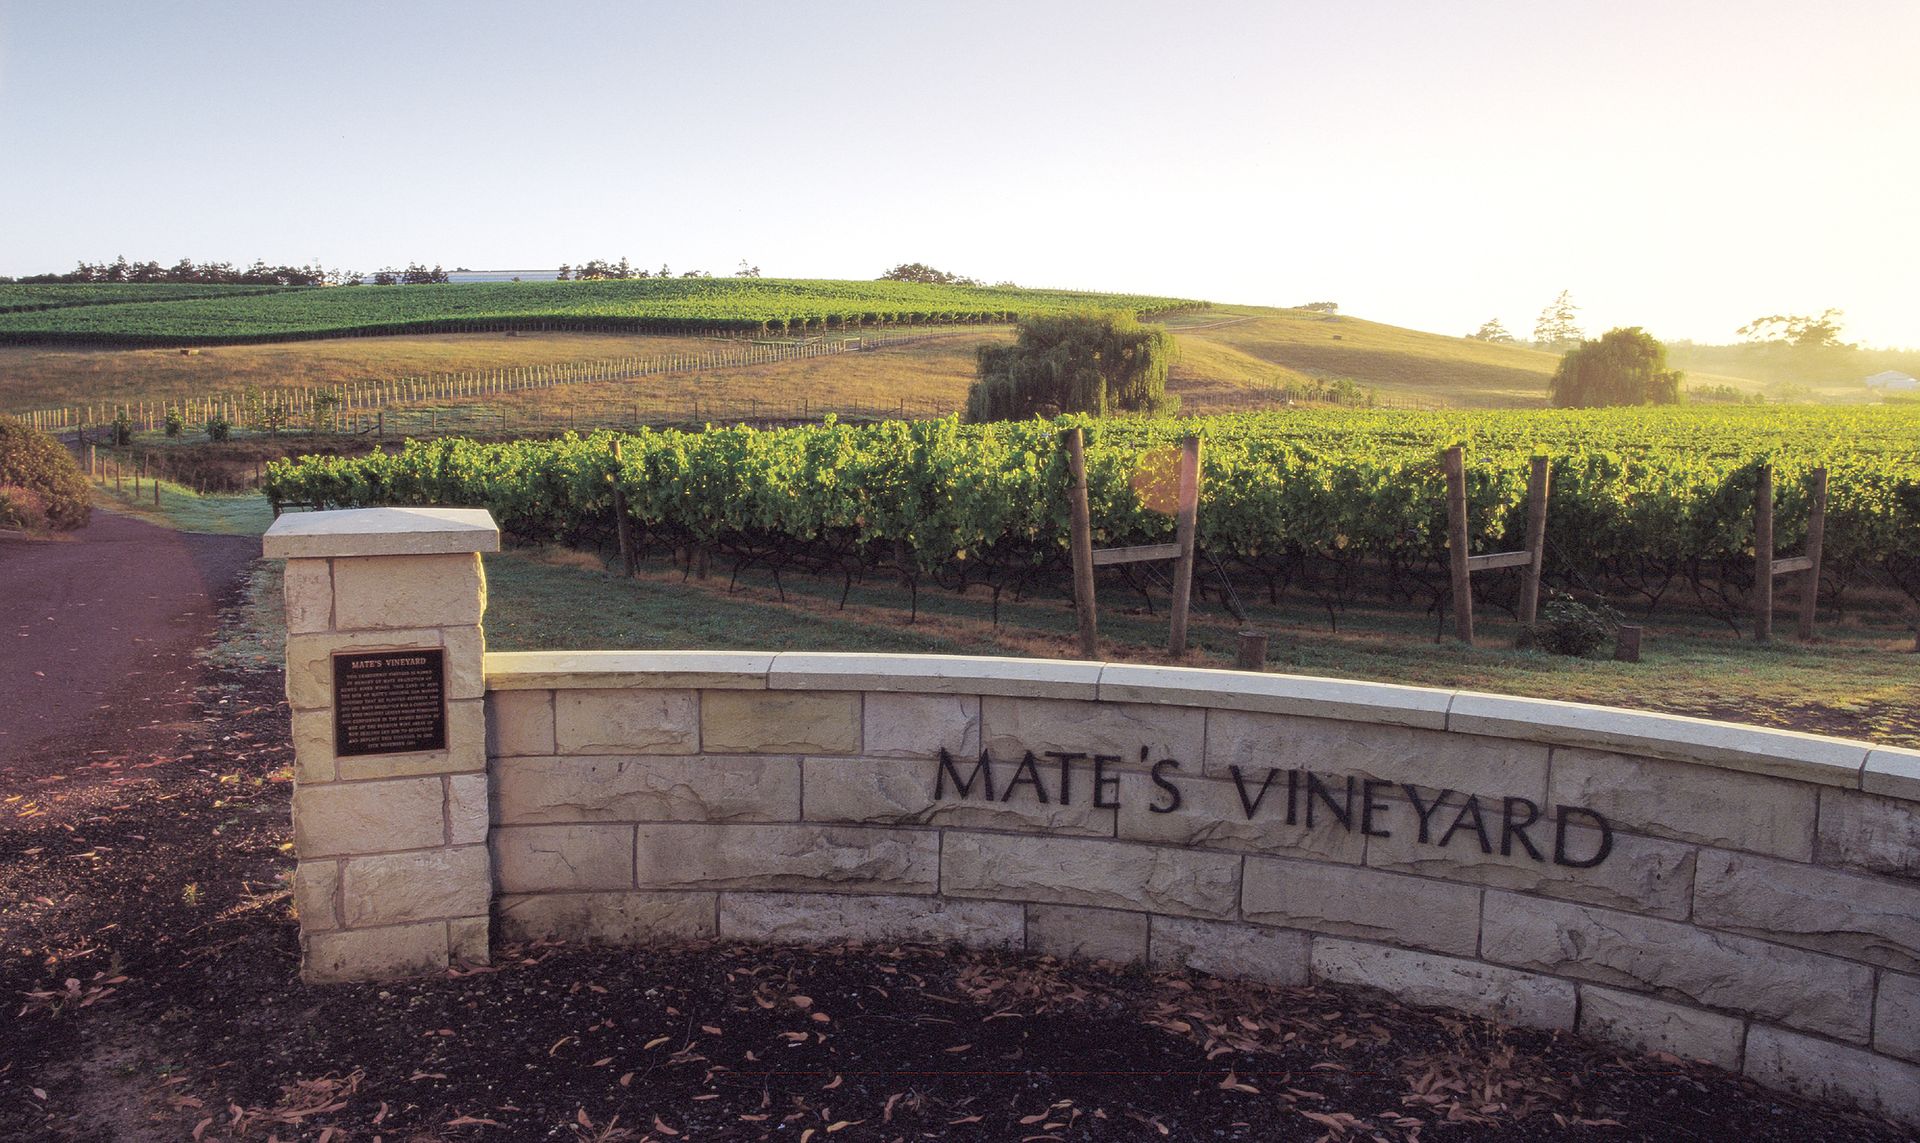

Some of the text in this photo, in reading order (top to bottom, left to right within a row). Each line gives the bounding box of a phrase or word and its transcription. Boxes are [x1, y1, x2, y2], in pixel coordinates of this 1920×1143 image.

[351, 657, 426, 669] MATE'S VINEYARD
[933, 746, 1614, 868] MATE'S VINEYARD
